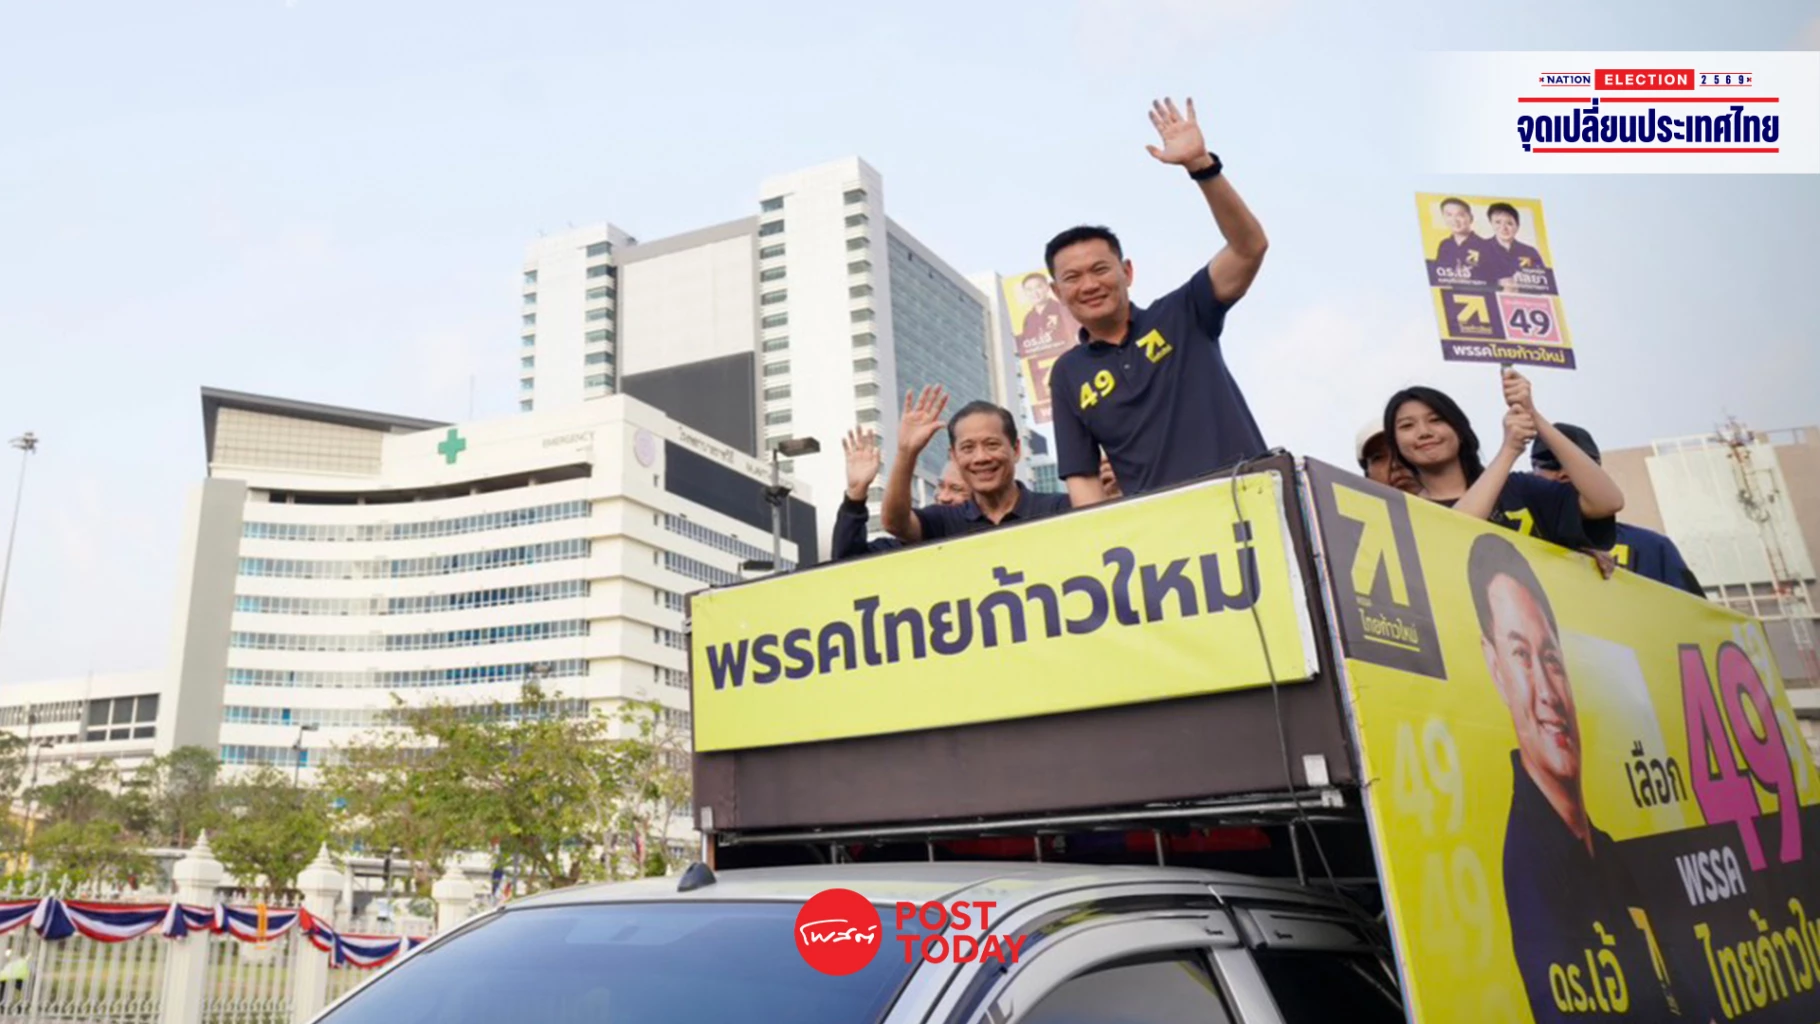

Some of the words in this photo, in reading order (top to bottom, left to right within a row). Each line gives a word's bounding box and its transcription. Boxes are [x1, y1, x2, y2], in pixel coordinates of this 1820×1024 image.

[1509, 308, 1551, 336] 49
[1080, 369, 1116, 411] 49
[706, 521, 1262, 690] พรรคไทยก้าวใหม่
[1392, 717, 1465, 838] 49
[1625, 741, 1688, 808] เลือก
[1677, 640, 1802, 871] 49
[1420, 845, 1495, 981] 49
[1675, 845, 1747, 907] พรรค
[1548, 921, 1630, 1013] ดร.เอ้
